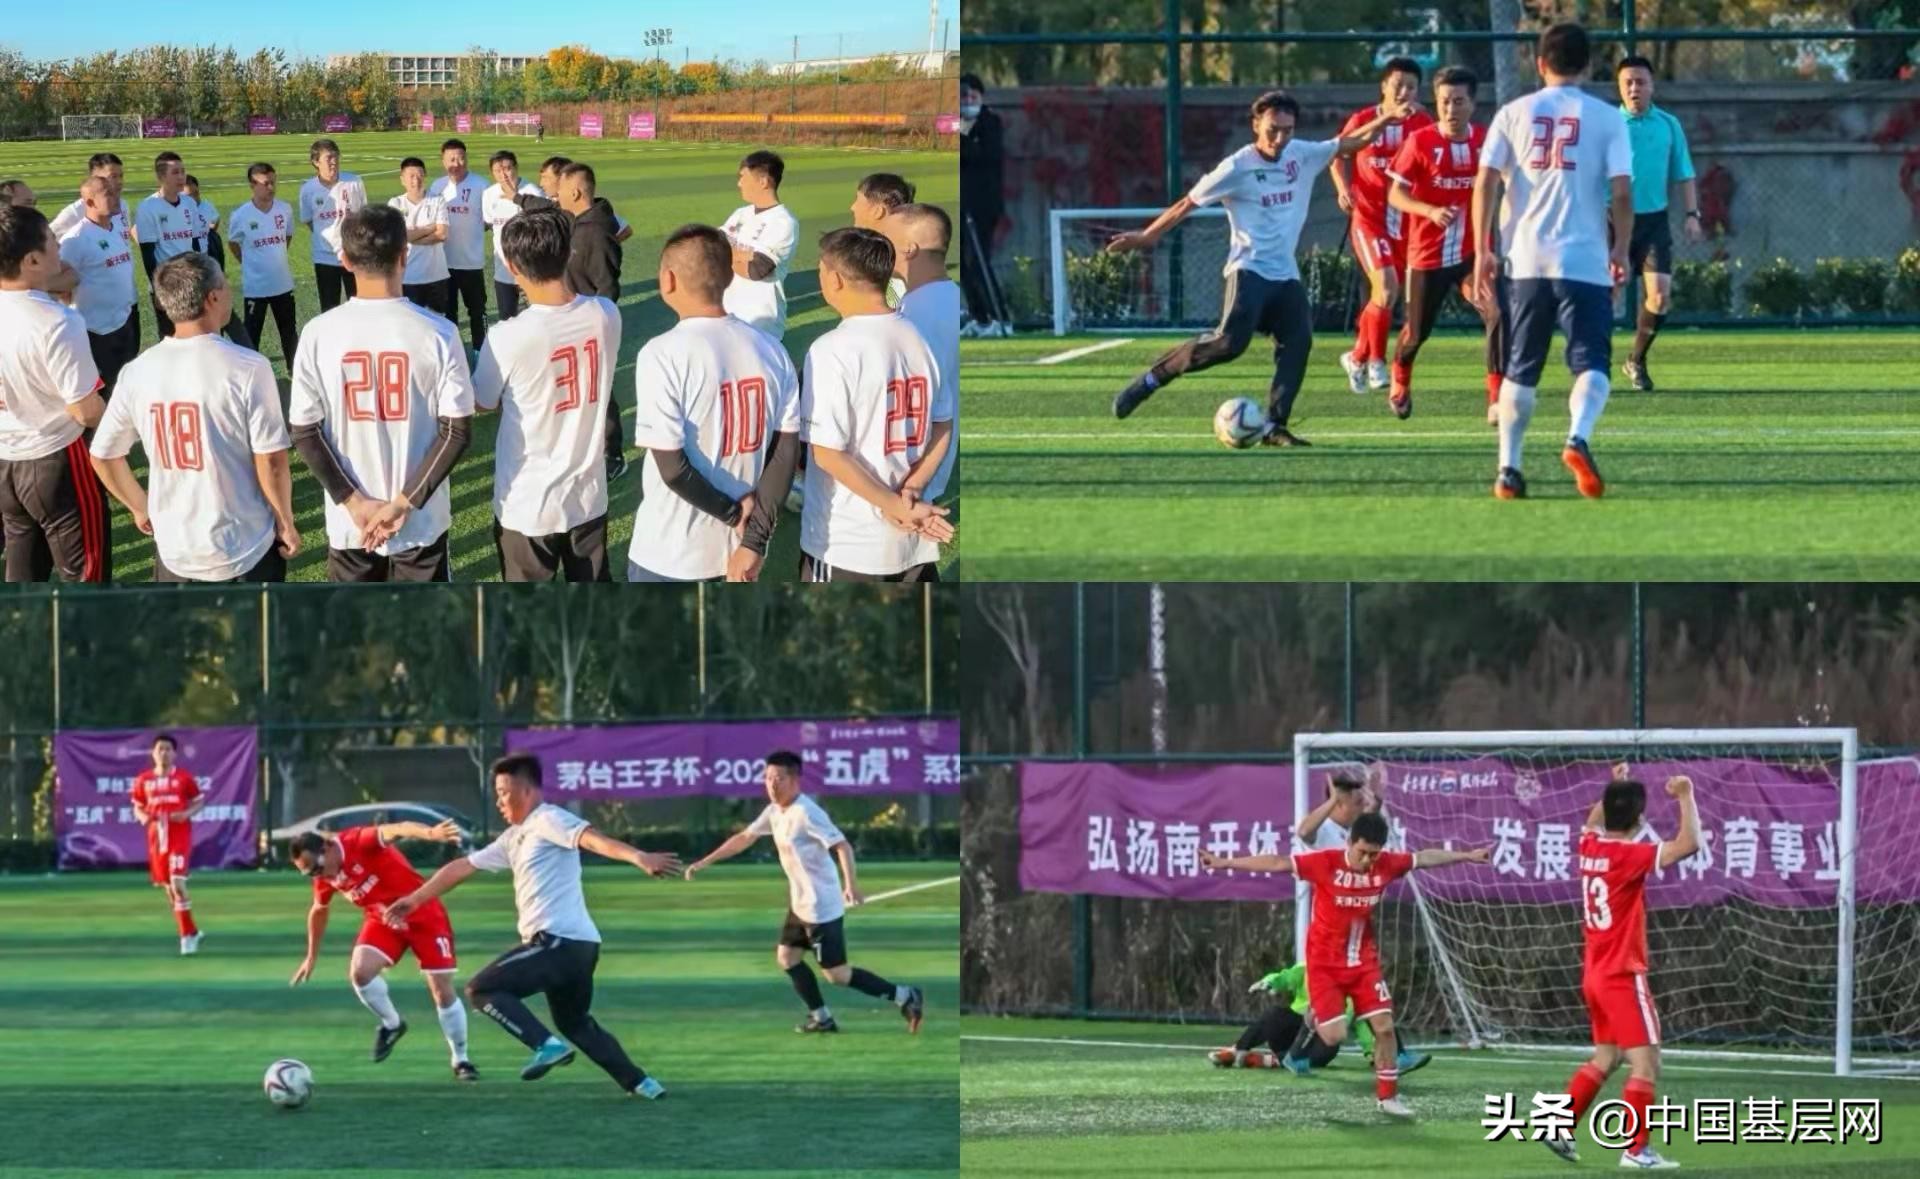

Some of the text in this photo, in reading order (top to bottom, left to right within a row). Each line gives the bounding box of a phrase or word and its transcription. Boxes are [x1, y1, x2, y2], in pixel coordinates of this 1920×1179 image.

[1432, 146, 1444, 166] 7
[1531, 116, 1580, 170] 32
[342, 350, 410, 422] 28
[551, 337, 599, 415] 31
[150, 402, 205, 472] 18
[720, 377, 766, 458] 10
[884, 375, 928, 457] 29
[556, 757, 769, 790] 茅台王子杯·202
[923, 753, 960, 784] 系
[1582, 874, 1613, 931] 13
